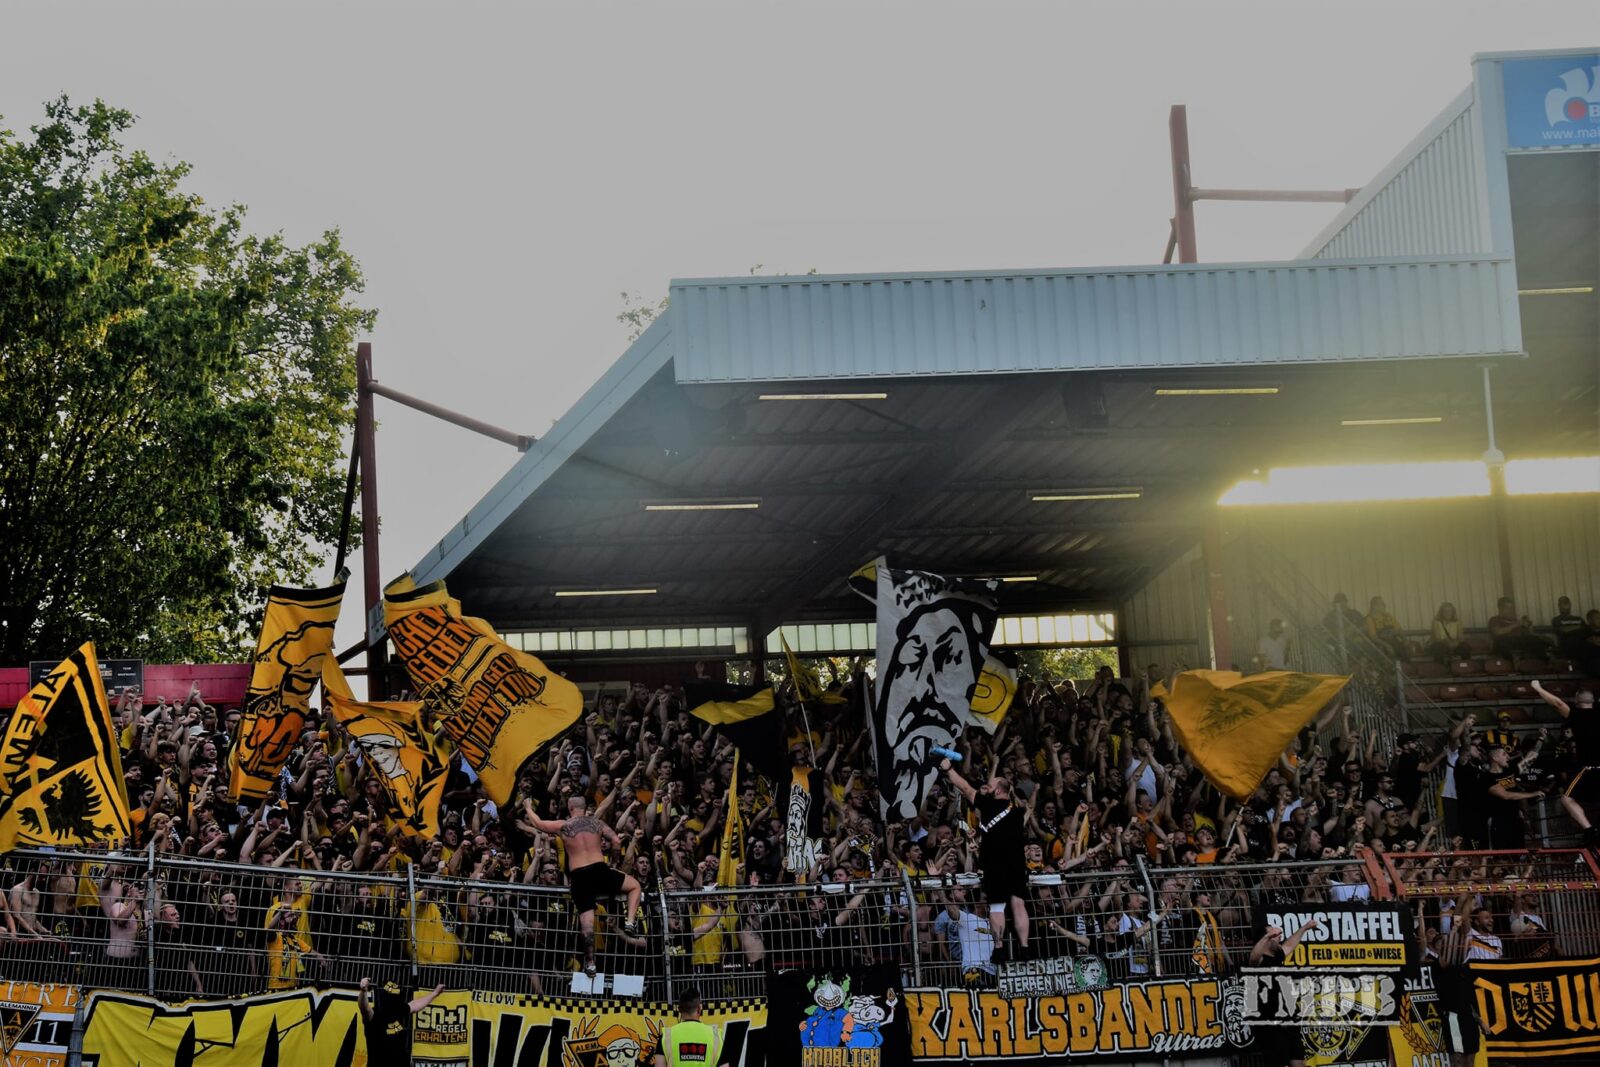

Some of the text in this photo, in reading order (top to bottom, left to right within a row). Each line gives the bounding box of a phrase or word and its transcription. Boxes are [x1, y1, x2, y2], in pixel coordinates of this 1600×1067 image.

[406, 619, 482, 685] GEBEN
[471, 696, 507, 746] DEN
[1267, 911, 1404, 942] BOXSTAFFEL
[1312, 948, 1332, 960] FELD
[1340, 948, 1365, 960] WALD
[1373, 947, 1402, 960] WIESE
[999, 956, 1073, 977] LEGENDEN
[1000, 974, 1052, 992] STERBEN
[1055, 972, 1076, 990] NIE!
[435, 1023, 467, 1034] REGEL
[907, 982, 1222, 1057] KARLSBANDE
[31, 1020, 60, 1045] 11
[414, 1031, 468, 1044] ERHALTEN!
[1153, 1032, 1226, 1053] Ultras
